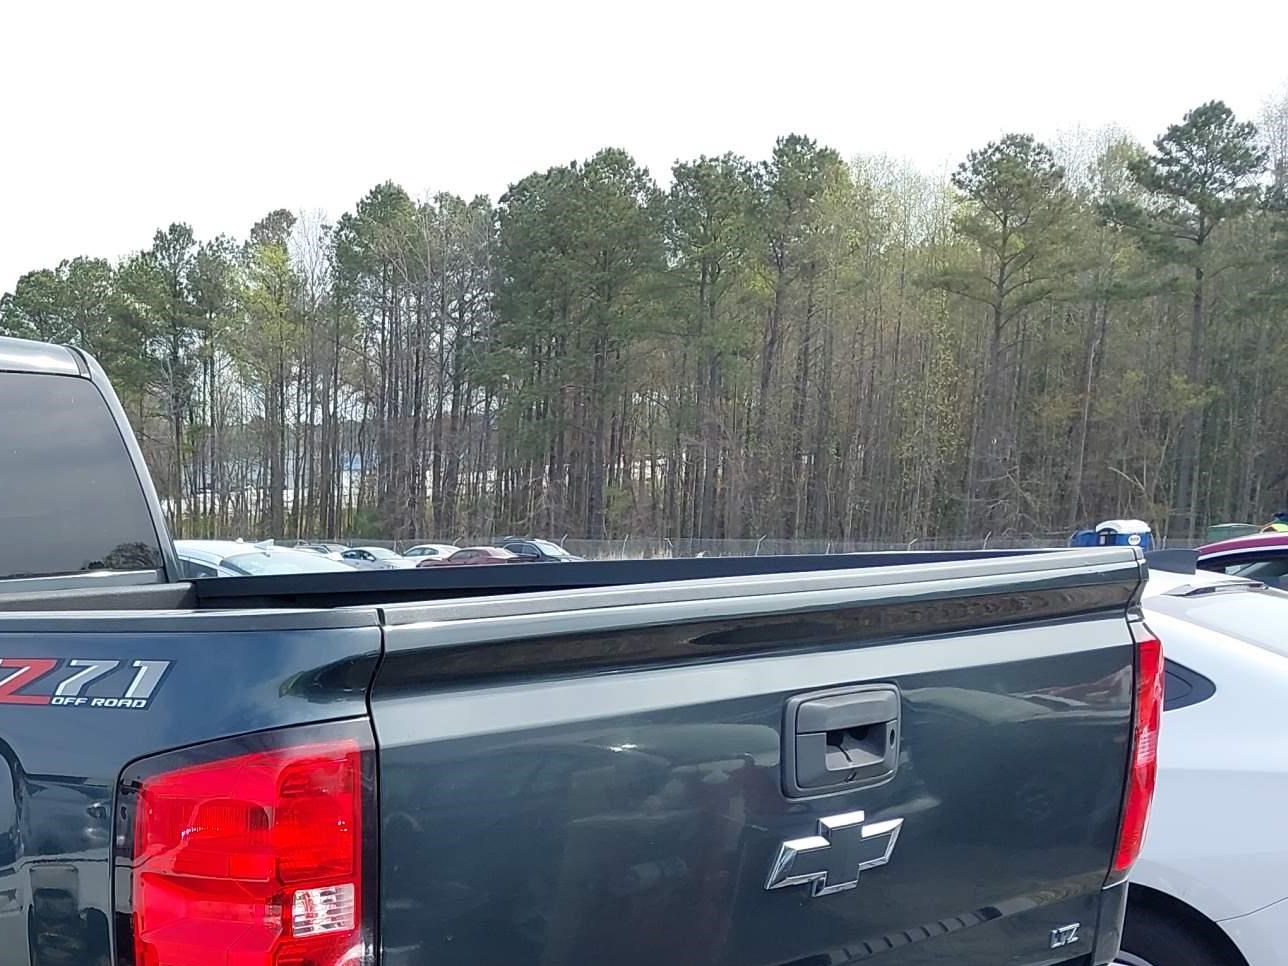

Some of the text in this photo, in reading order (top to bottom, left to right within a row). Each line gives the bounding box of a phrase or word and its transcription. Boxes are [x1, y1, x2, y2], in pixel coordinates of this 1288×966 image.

[51, 697, 147, 709] OFF ROAD
[1050, 922, 1081, 949] LTZ
